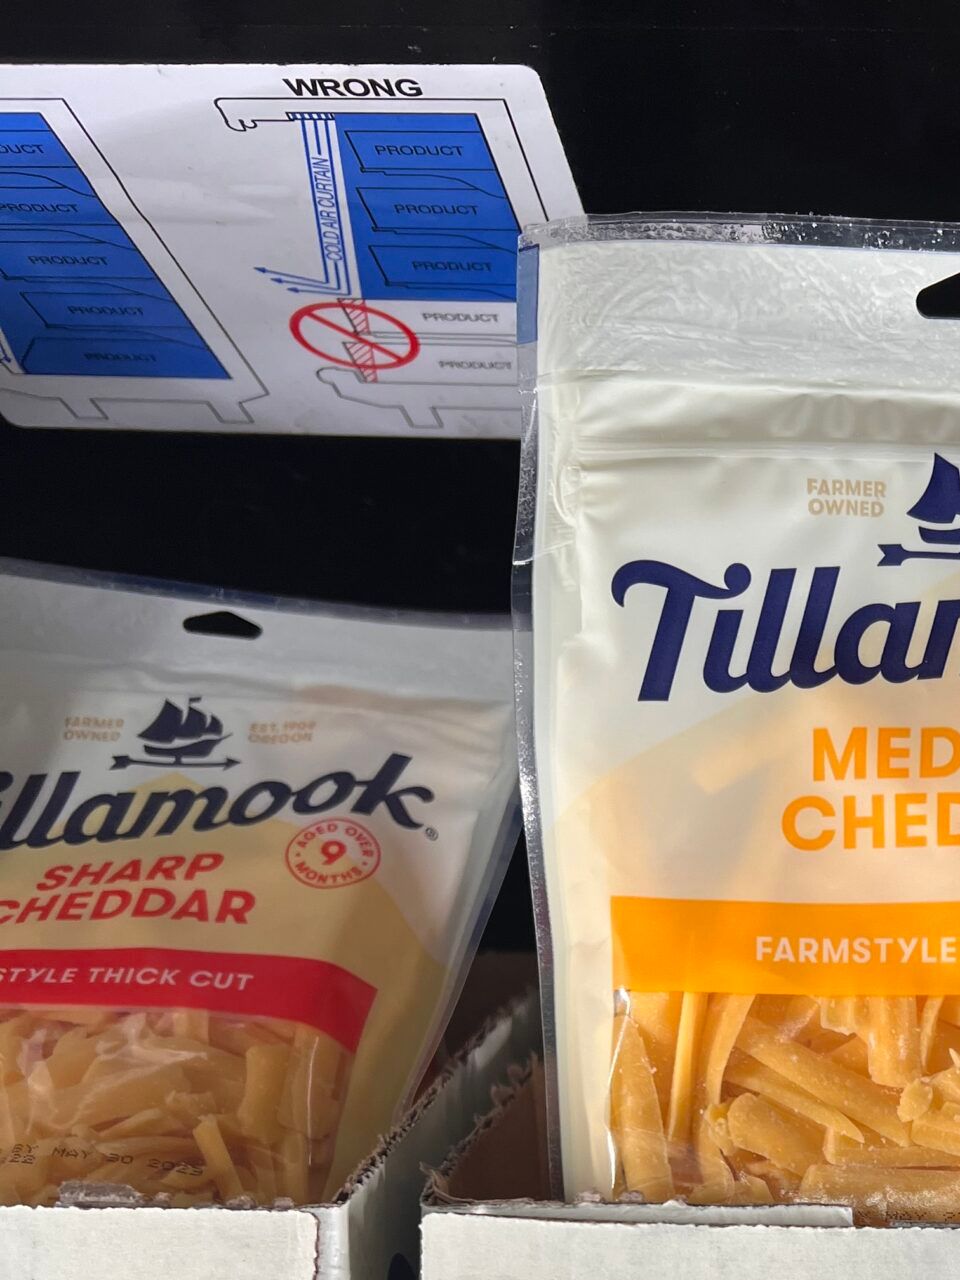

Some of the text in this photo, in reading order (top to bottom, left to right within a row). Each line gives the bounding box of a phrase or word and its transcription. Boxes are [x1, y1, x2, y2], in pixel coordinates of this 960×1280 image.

[283, 78, 423, 97] WRONG
[374, 145, 464, 157] PRODUCT
[312, 156, 342, 261] COLD AIR CURTAIN
[394, 204, 480, 216] PRODUCT
[28, 255, 107, 266] PRODUCT
[412, 261, 493, 273] PRODUCT
[422, 312, 499, 324] PRODUCT
[806, 478, 887, 499] FARMER
[808, 499, 885, 518] OWNED
[296, 823, 374, 857] AGED OVER
[320, 840, 347, 865] 9
[36, 853, 225, 891] SHARP
[295, 861, 363, 883] MONTHS
[755, 935, 958, 964] FARMSTYLE
[89, 968, 254, 991] THICK CUT
